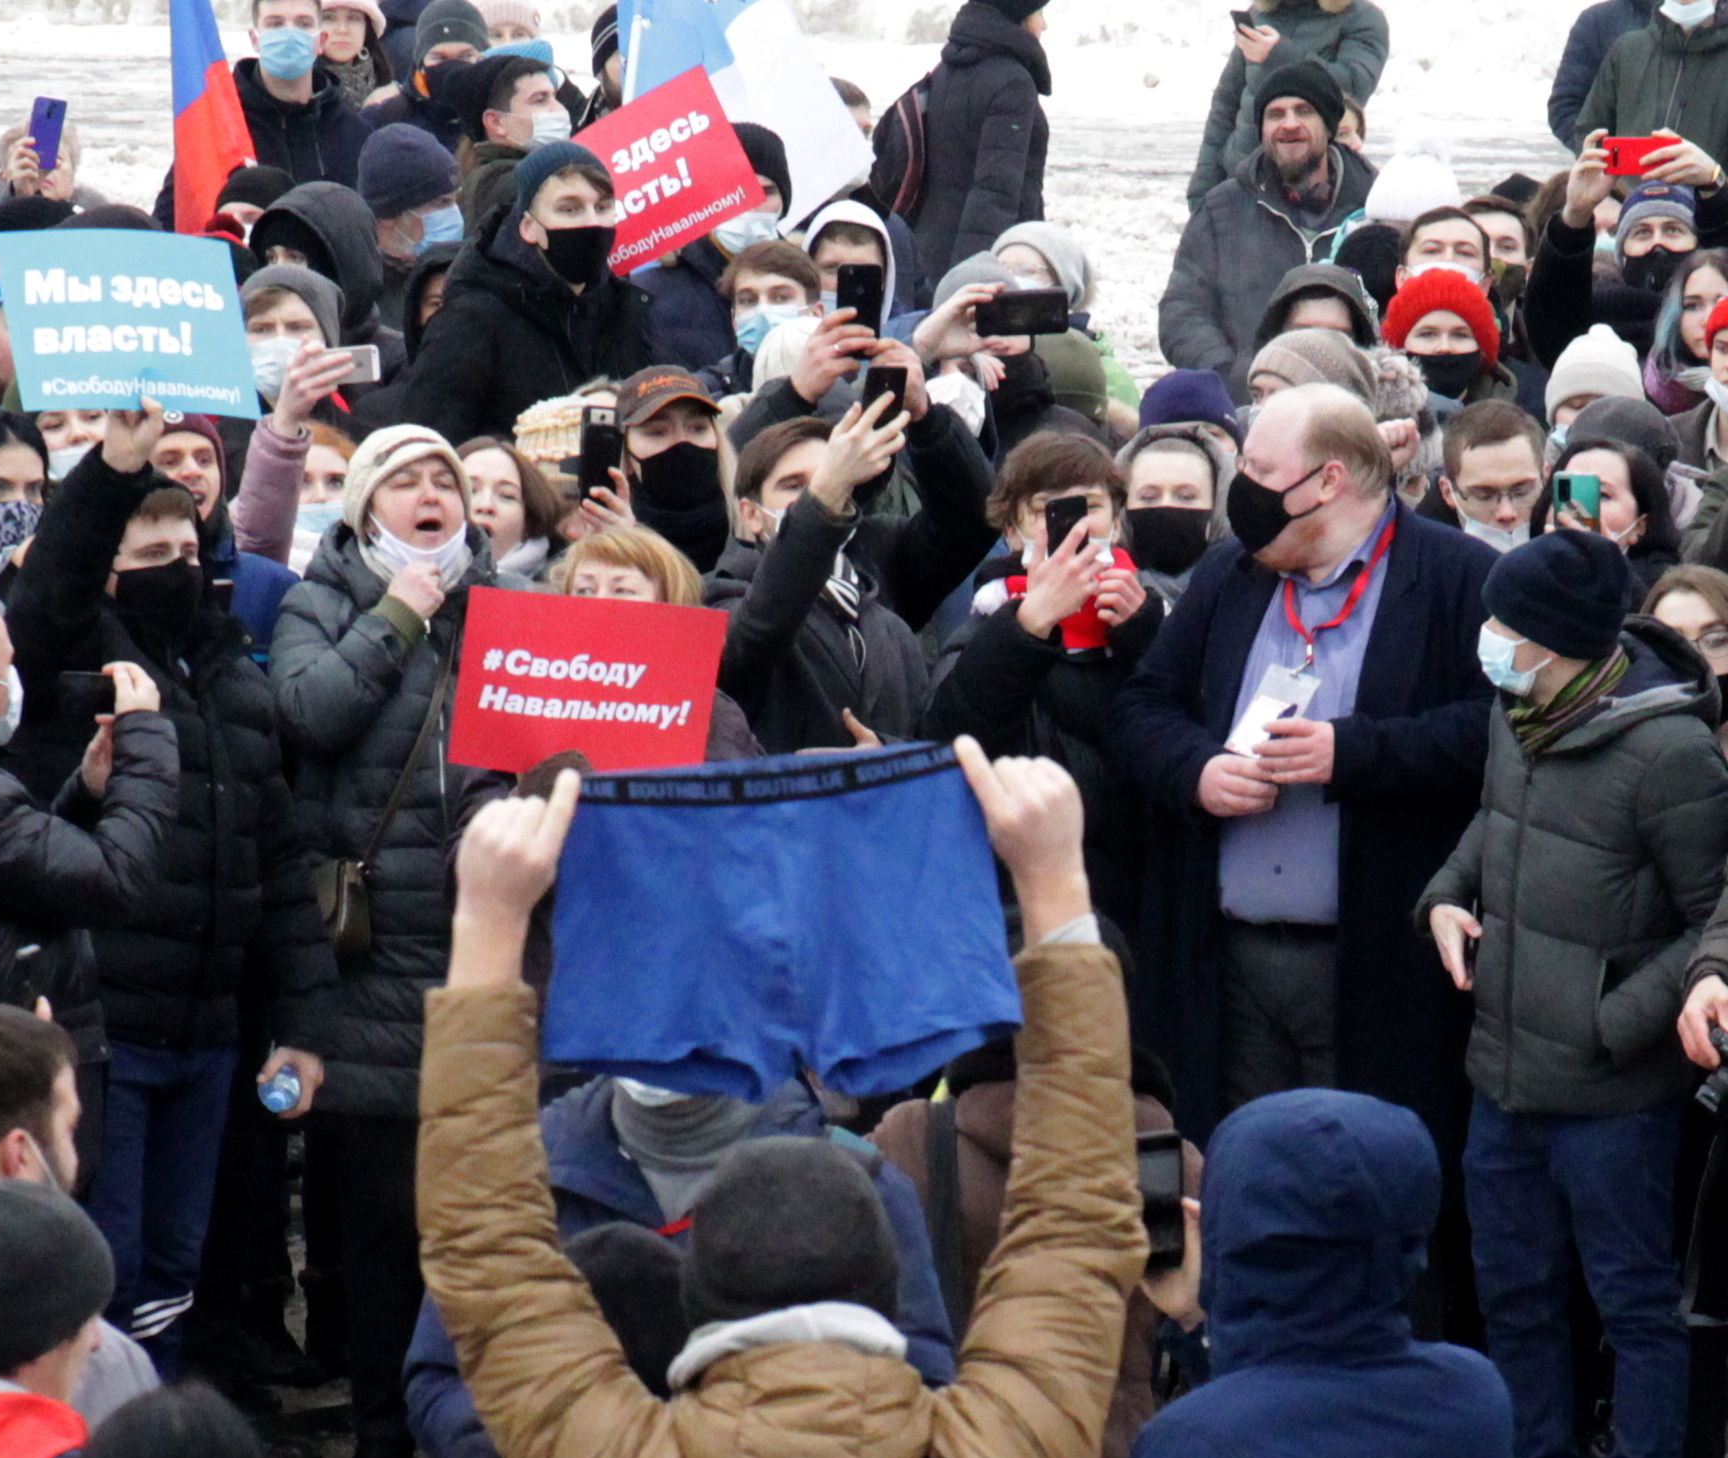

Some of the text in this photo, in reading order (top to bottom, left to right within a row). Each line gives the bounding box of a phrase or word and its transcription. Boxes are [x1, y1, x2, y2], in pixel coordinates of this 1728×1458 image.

[611, 110, 710, 174] здесь
[24, 268, 225, 311] Мы здесь
[33, 320, 193, 356] власть!
[41, 374, 242, 405] #СвободуНавальному!
[482, 648, 647, 689] #Свободу
[477, 684, 692, 731] Навальному!
